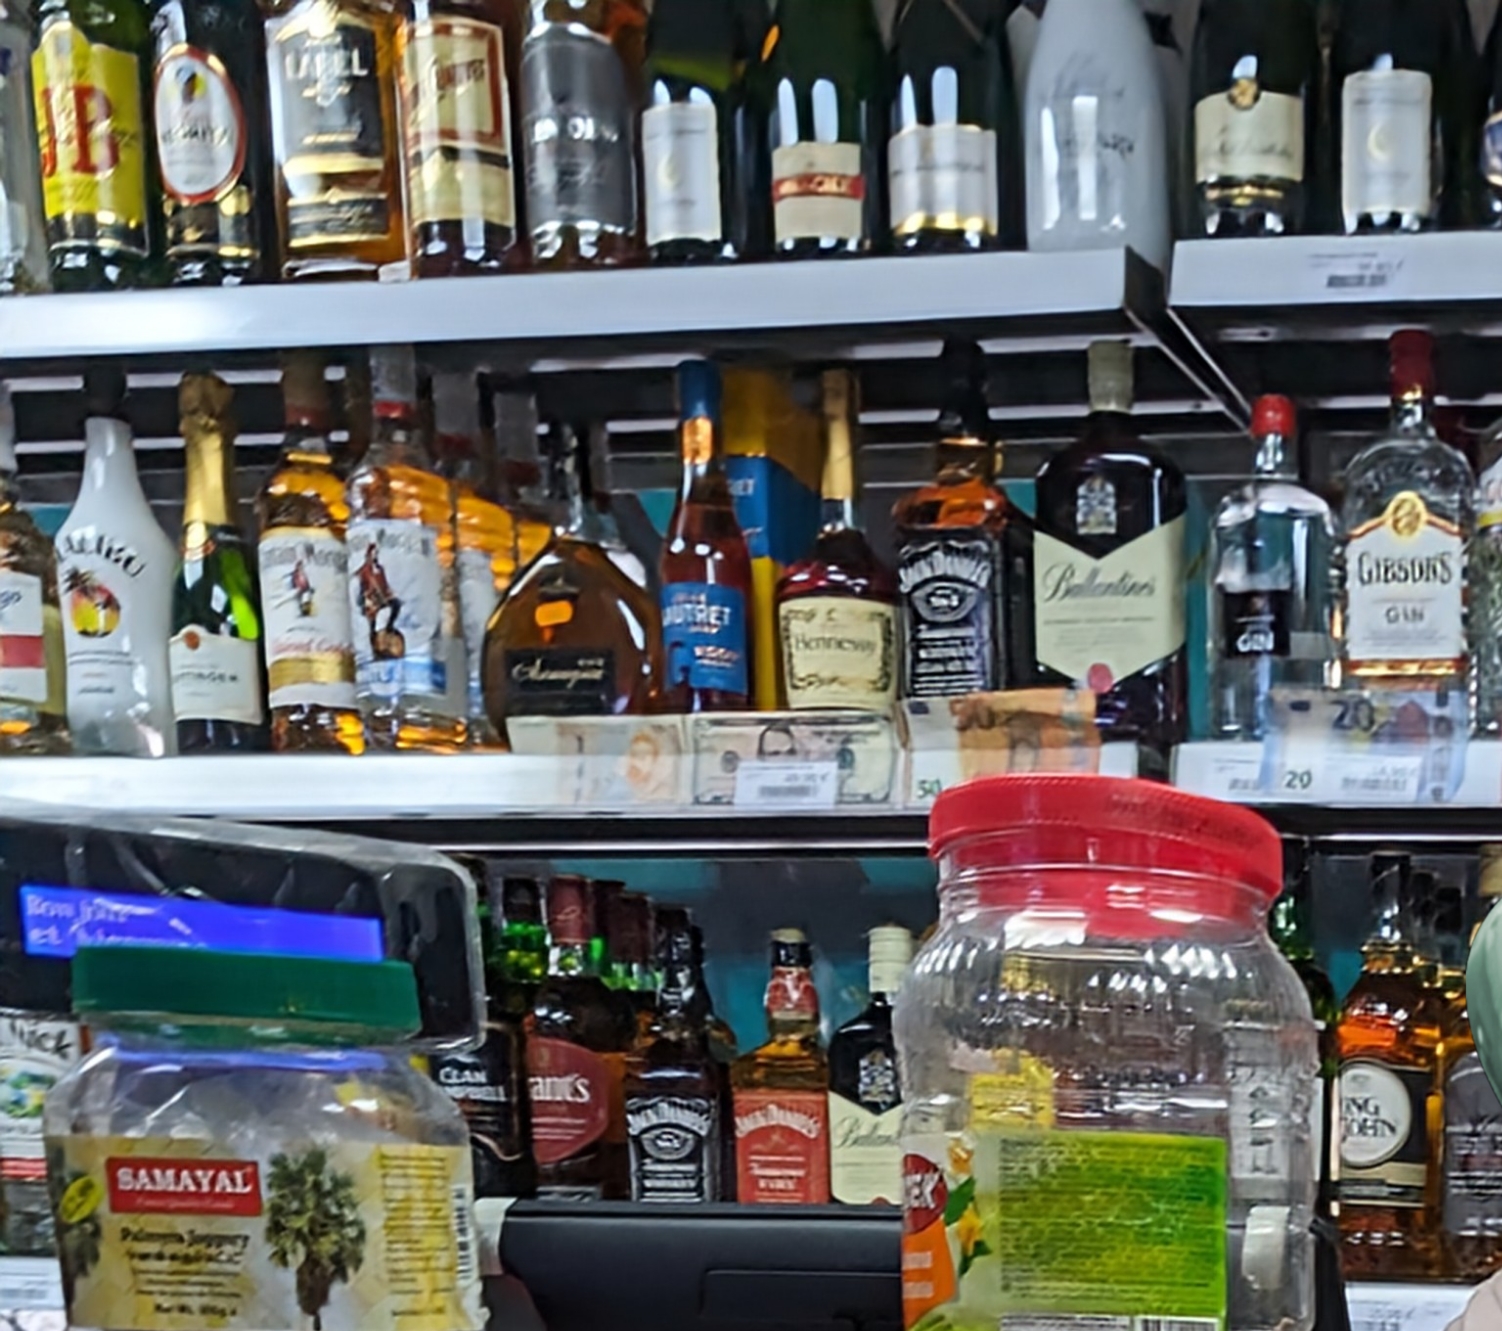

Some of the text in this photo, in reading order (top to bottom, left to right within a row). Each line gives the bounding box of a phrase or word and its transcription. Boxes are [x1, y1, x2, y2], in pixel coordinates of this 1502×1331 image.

[1357, 551, 1453, 586] GIBSON'S
[1284, 769, 1313, 790] 20
[116, 1167, 254, 1194] SAMAYAL
